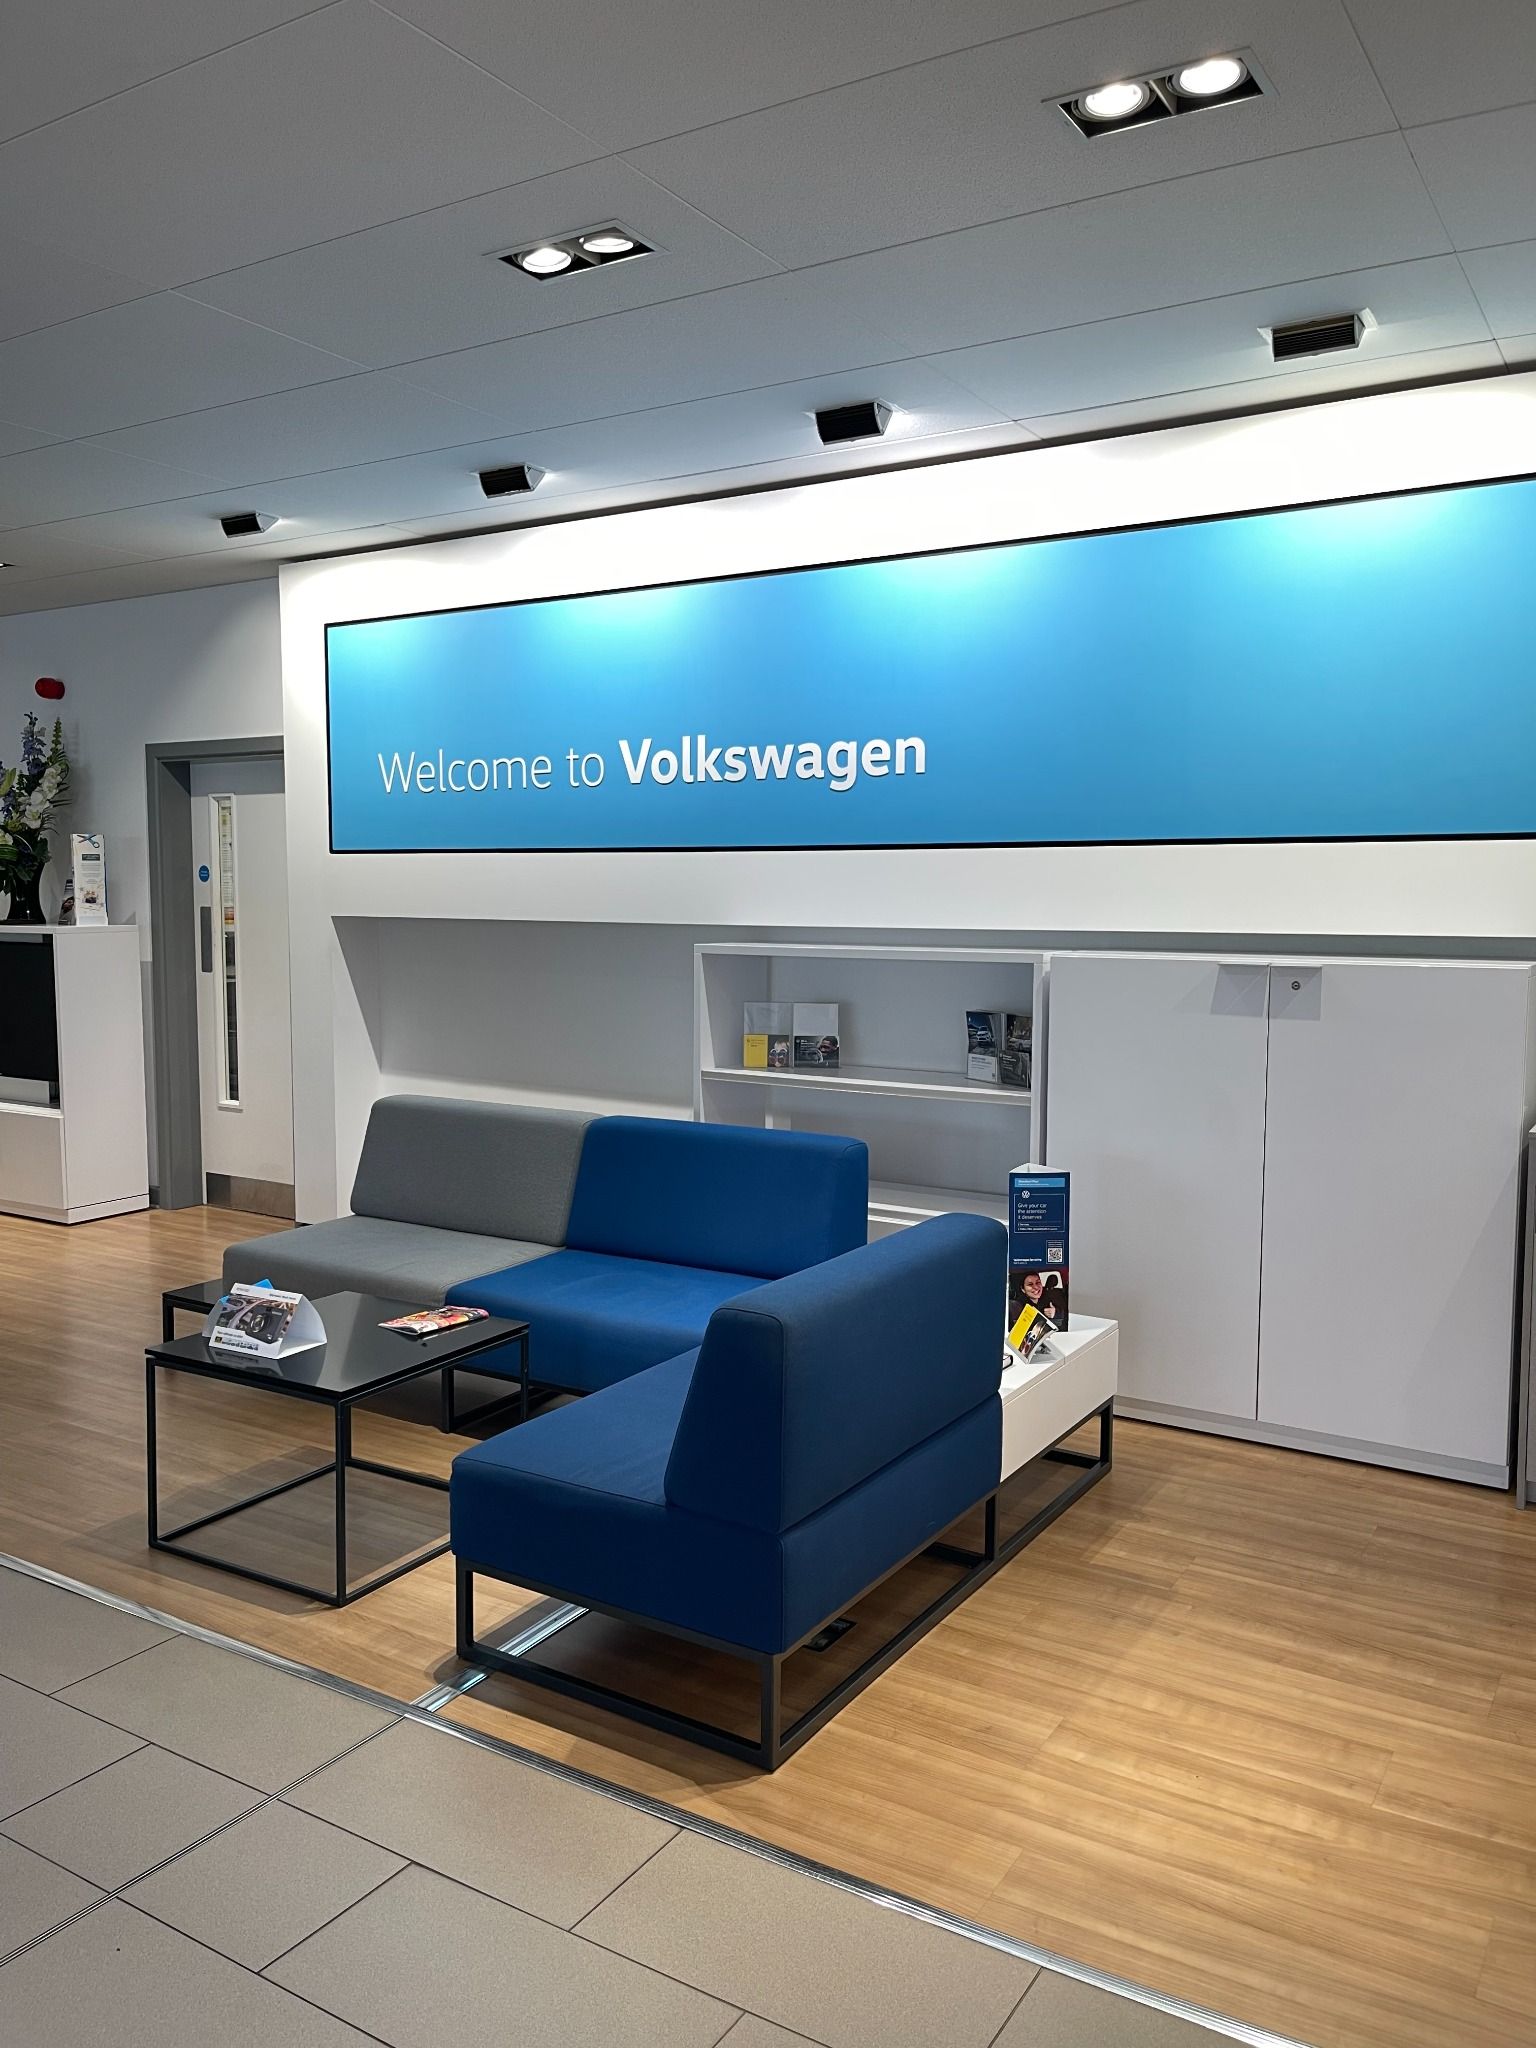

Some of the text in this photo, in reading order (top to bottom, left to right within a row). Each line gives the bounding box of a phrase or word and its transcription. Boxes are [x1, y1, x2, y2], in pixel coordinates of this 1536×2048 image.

[377, 734, 926, 793] Welcome to Volkswagen
